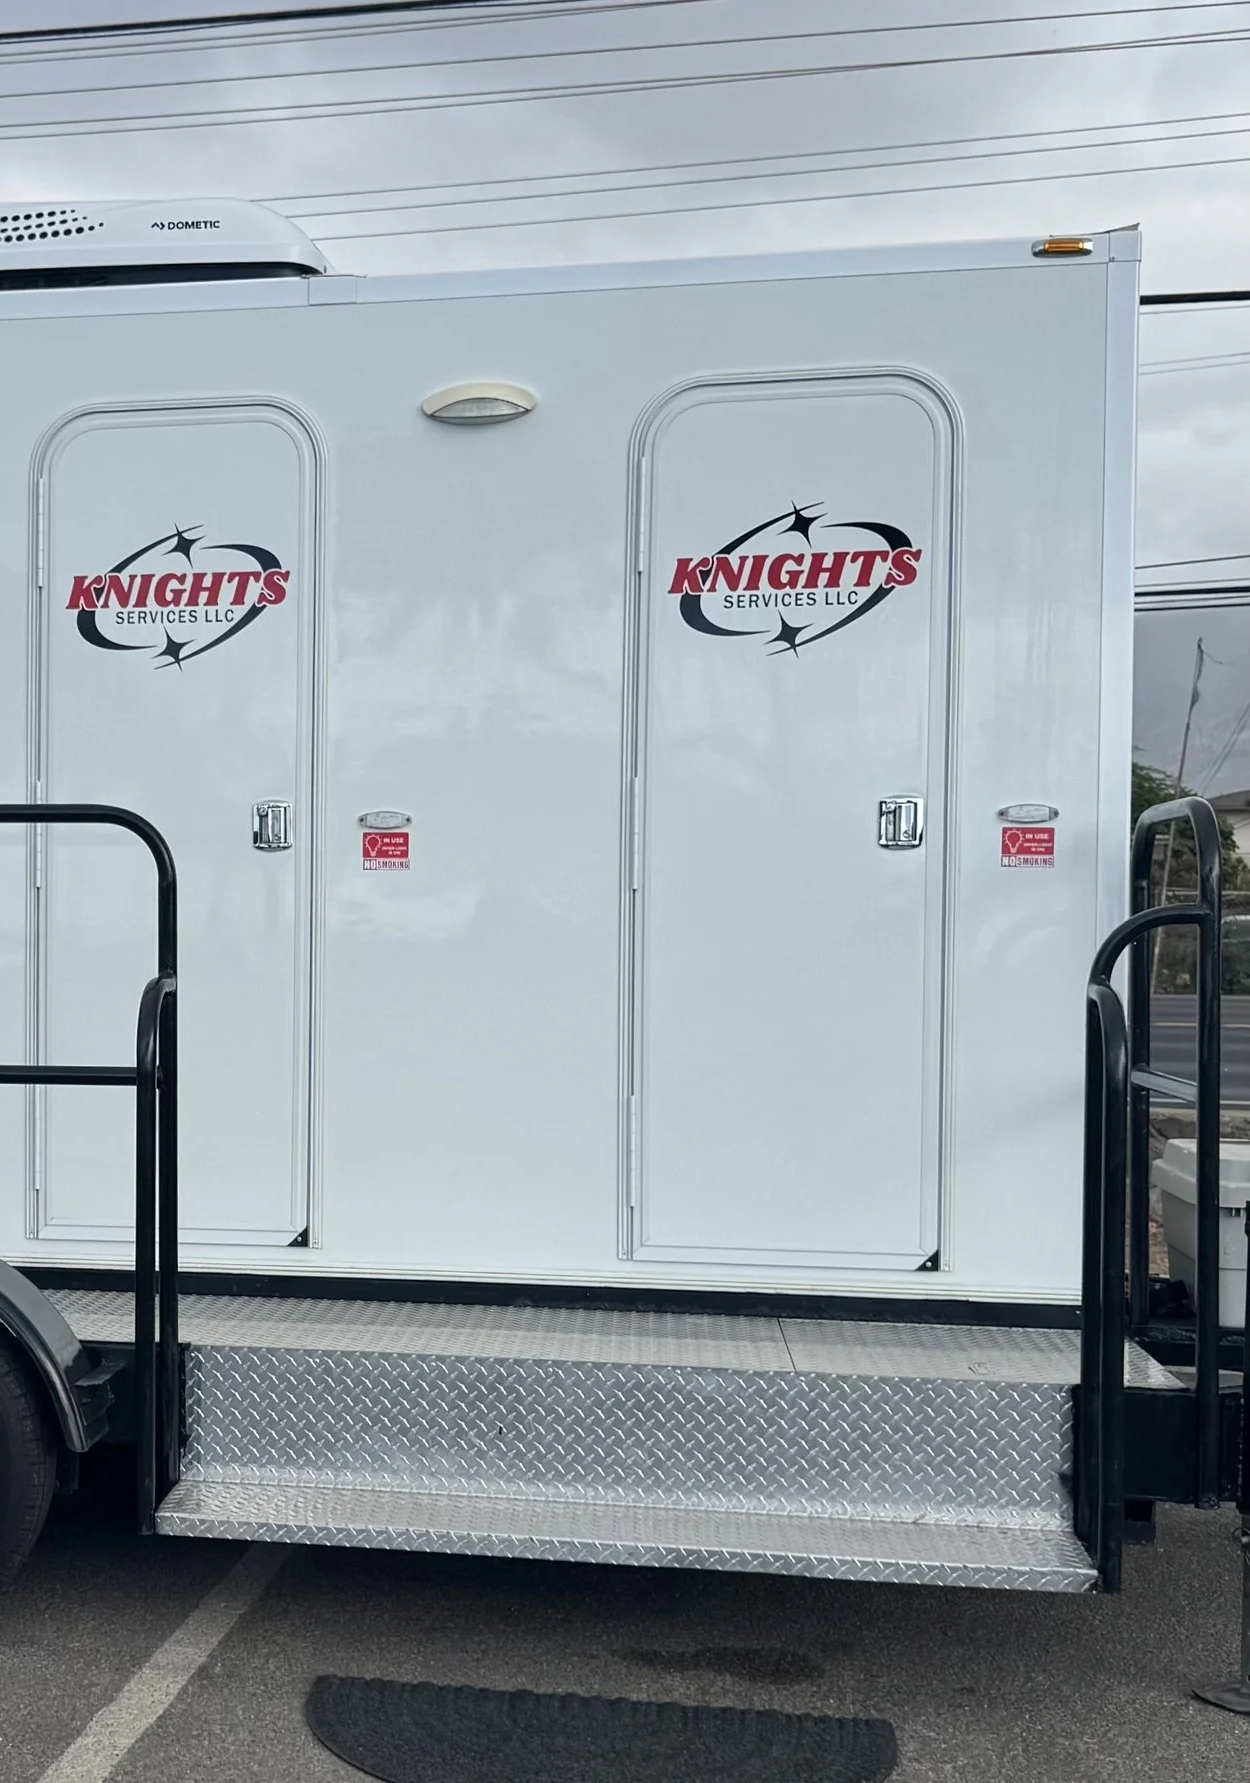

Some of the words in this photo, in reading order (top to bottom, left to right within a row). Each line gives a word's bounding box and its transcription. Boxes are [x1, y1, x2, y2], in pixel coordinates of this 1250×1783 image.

[167, 220, 220, 230] DOMETIC
[667, 548, 923, 595] KNIGHTS
[65, 569, 291, 610] KNIGHTS
[723, 591, 817, 609] SERVICES
[825, 590, 858, 605] LLC
[115, 609, 198, 625] SERVICES
[204, 608, 235, 624] LLC
[364, 860, 377, 870] NO
[377, 860, 410, 870] SMOKING
[1002, 856, 1016, 867] NO
[1017, 856, 1054, 867] SMOKING
